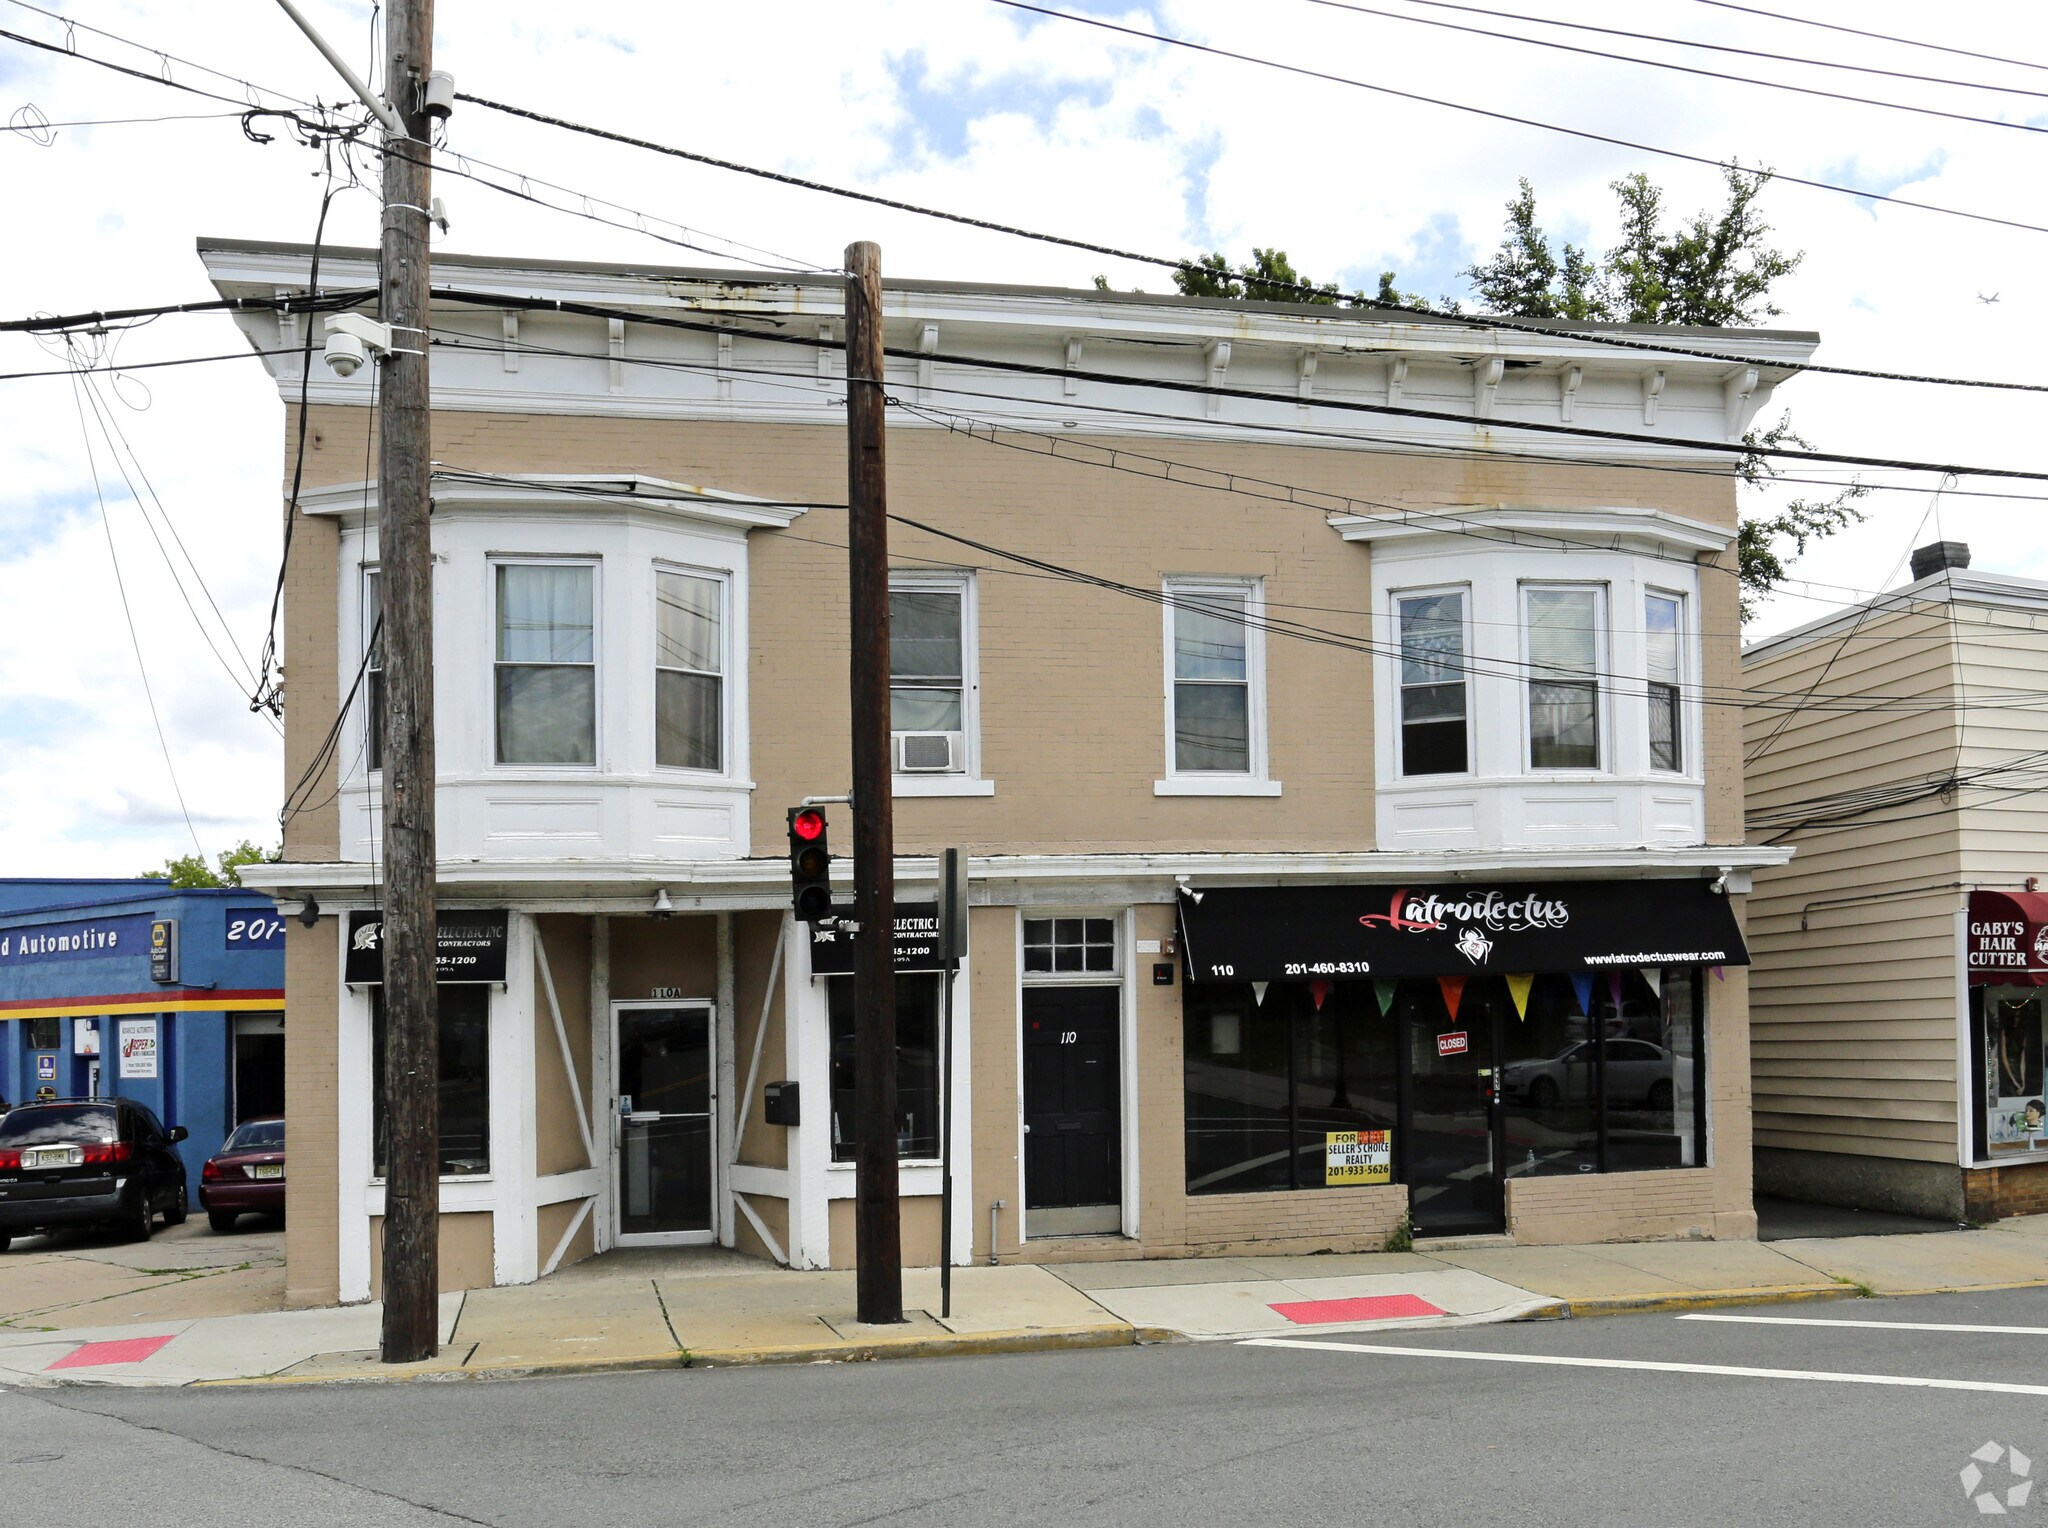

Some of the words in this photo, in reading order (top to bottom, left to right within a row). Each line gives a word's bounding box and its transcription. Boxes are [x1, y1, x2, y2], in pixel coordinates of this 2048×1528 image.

[1359, 888, 1569, 933] Latrodectus
[227, 918, 286, 940] 201-
[436, 926, 484, 938] ELECTRIC
[1971, 921, 2024, 936] GABY'S
[19, 928, 117, 955] Automotive
[1979, 937, 2016, 951] HAIR
[1968, 951, 2027, 966] CUTTER
[1211, 964, 1235, 976] 110
[1284, 961, 1370, 975] 201-460-8310
[652, 988, 680, 998] 110A
[1060, 1031, 1077, 1044] 110
[1439, 1037, 1466, 1050] CLOSED
[1335, 1133, 1356, 1143] FOR
[1328, 1144, 1362, 1155] SELLER'S
[1363, 1142, 1389, 1153] CHOICE
[1345, 1154, 1373, 1165] REALTY
[1327, 1165, 1389, 1176] 201-933-5626
